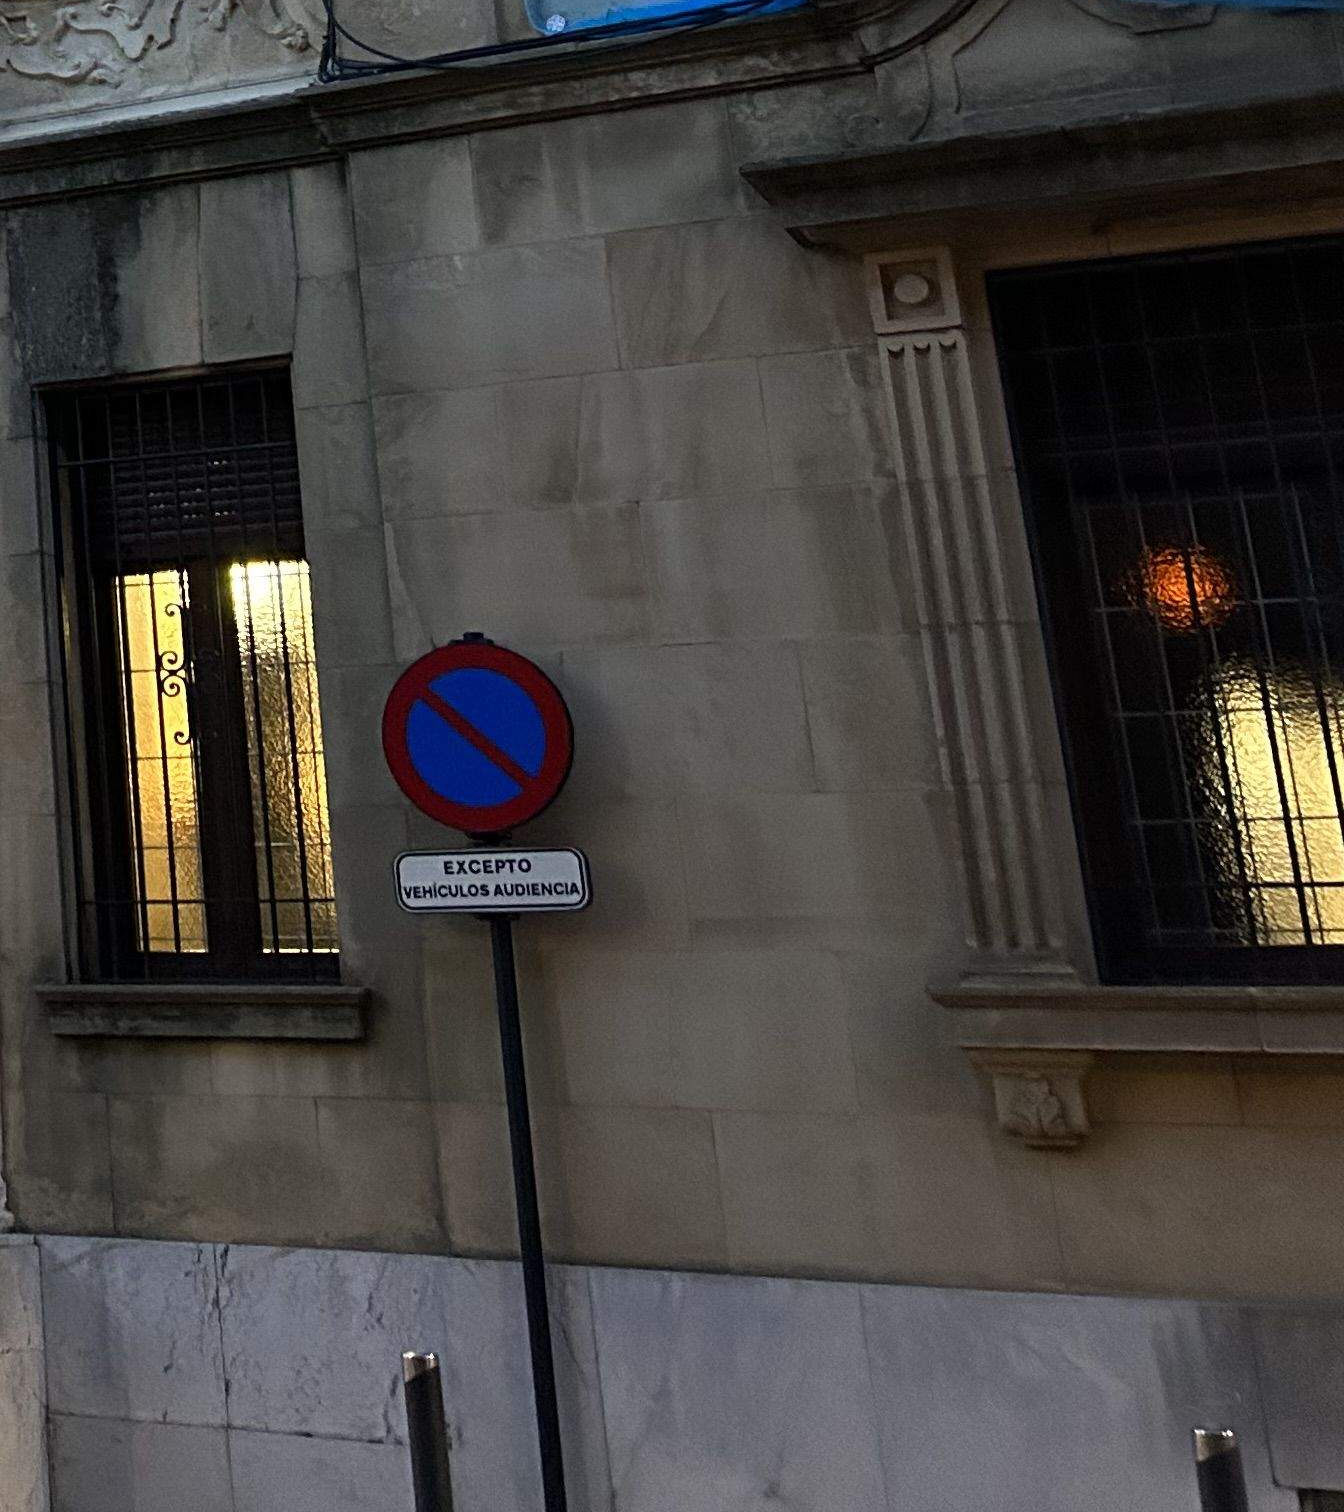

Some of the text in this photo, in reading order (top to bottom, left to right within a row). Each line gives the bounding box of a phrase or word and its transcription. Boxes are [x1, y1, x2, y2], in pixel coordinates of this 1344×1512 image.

[443, 858, 532, 875] EXCEPTO
[403, 881, 581, 899] VEHÍCULOS AUDIENCIA
